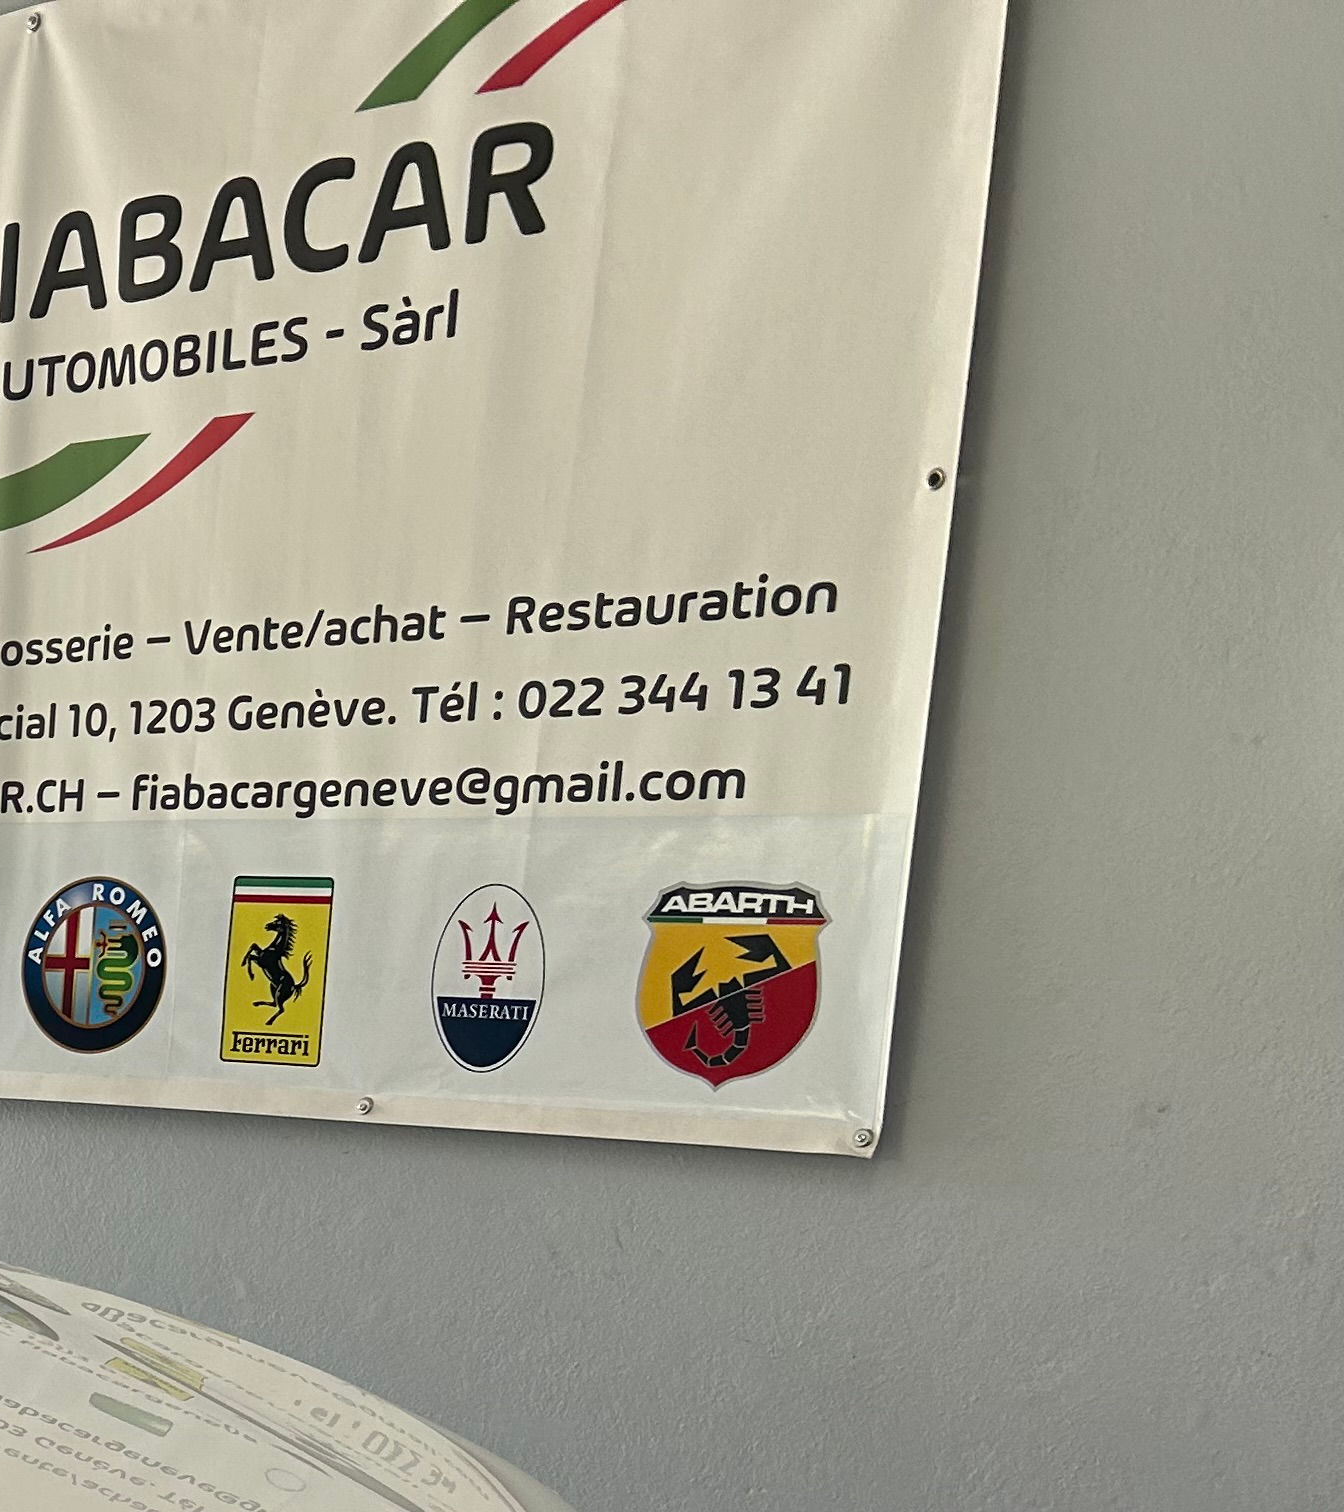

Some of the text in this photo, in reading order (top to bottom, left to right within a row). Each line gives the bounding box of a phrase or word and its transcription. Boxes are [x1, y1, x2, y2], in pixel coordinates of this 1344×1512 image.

[359, 286, 461, 353] Sàrl
[182, 602, 448, 657] Vente/achat
[504, 571, 839, 637] Restauration
[67, 701, 118, 744] 10,
[128, 695, 218, 737] 1203
[226, 687, 398, 733] Genève.
[410, 679, 480, 725] Tél
[517, 675, 606, 721] 022
[616, 670, 710, 717] 344
[727, 666, 782, 711] 13
[795, 661, 853, 707] 41
[130, 759, 747, 821] fiabacargeneve@gmail.com
[27, 882, 162, 969] ALFA ROMEO
[658, 891, 816, 915] ABARTH
[230, 1030, 311, 1057] Ferrari
[441, 1002, 530, 1021] MASERATI
